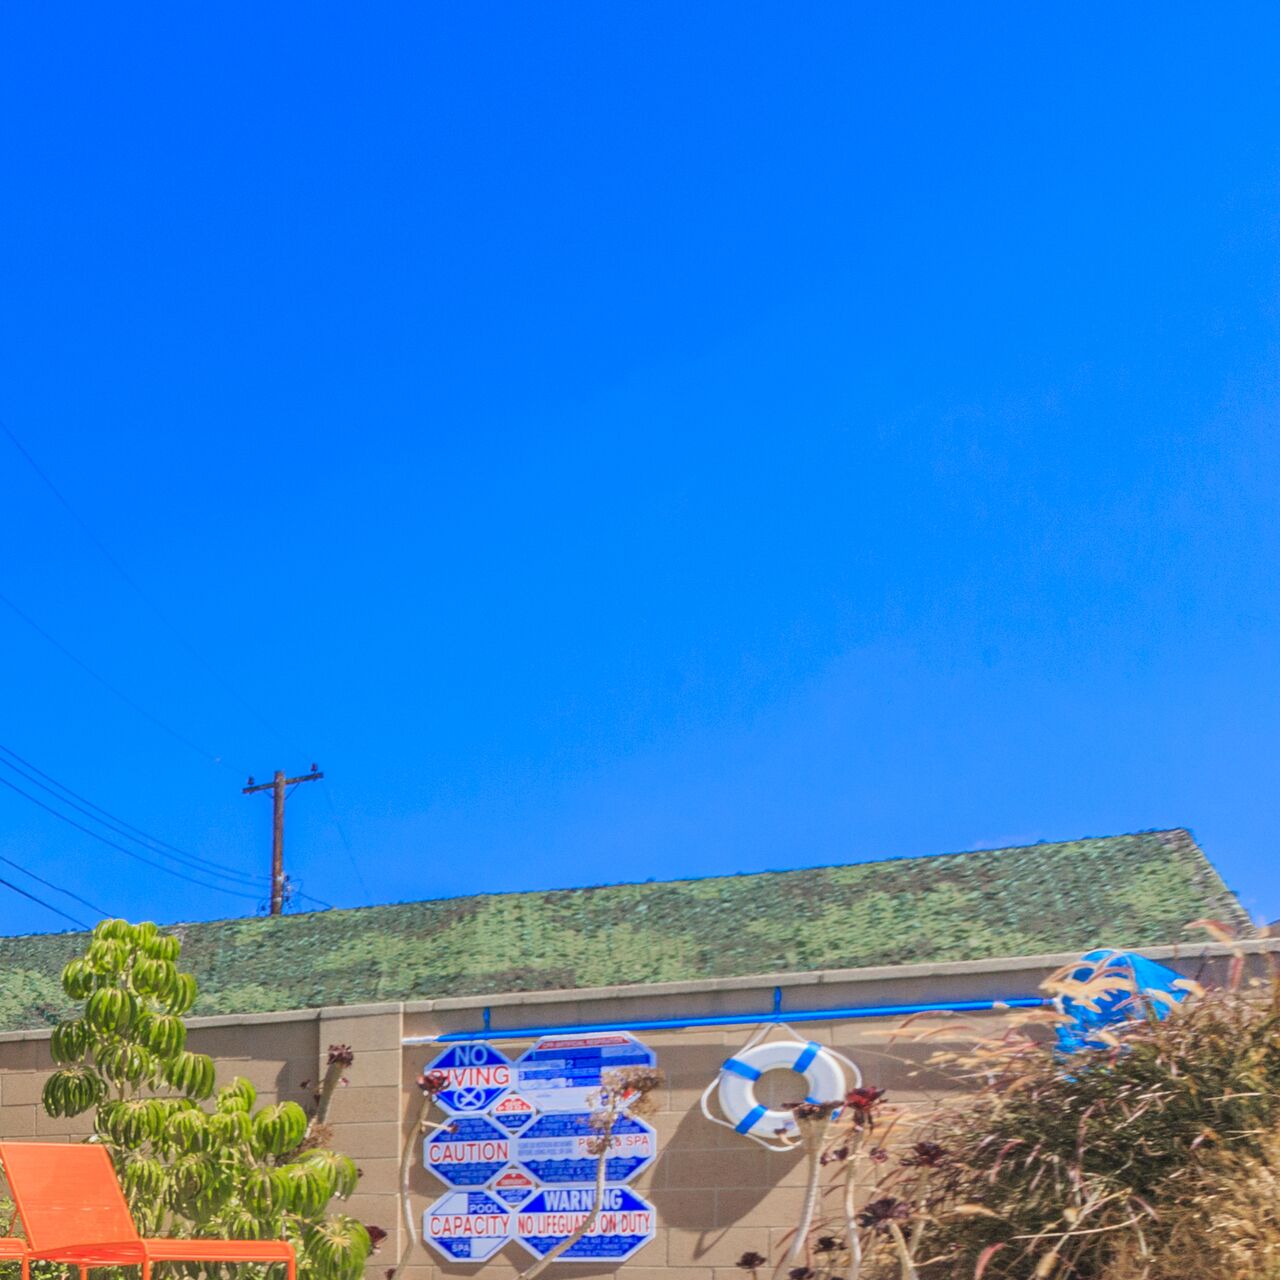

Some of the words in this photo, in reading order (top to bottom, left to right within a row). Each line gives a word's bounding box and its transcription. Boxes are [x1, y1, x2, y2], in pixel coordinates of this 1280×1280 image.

[454, 1045, 488, 1066] NO
[626, 1134, 649, 1146] SPA
[429, 1142, 509, 1162] CAUTION
[469, 1204, 501, 1213] POOL
[543, 1189, 623, 1211] WARNNG
[430, 1215, 510, 1235] CAPACITY
[518, 1215, 533, 1234] NO
[600, 1214, 617, 1233] ON
[621, 1213, 650, 1233] DUTY
